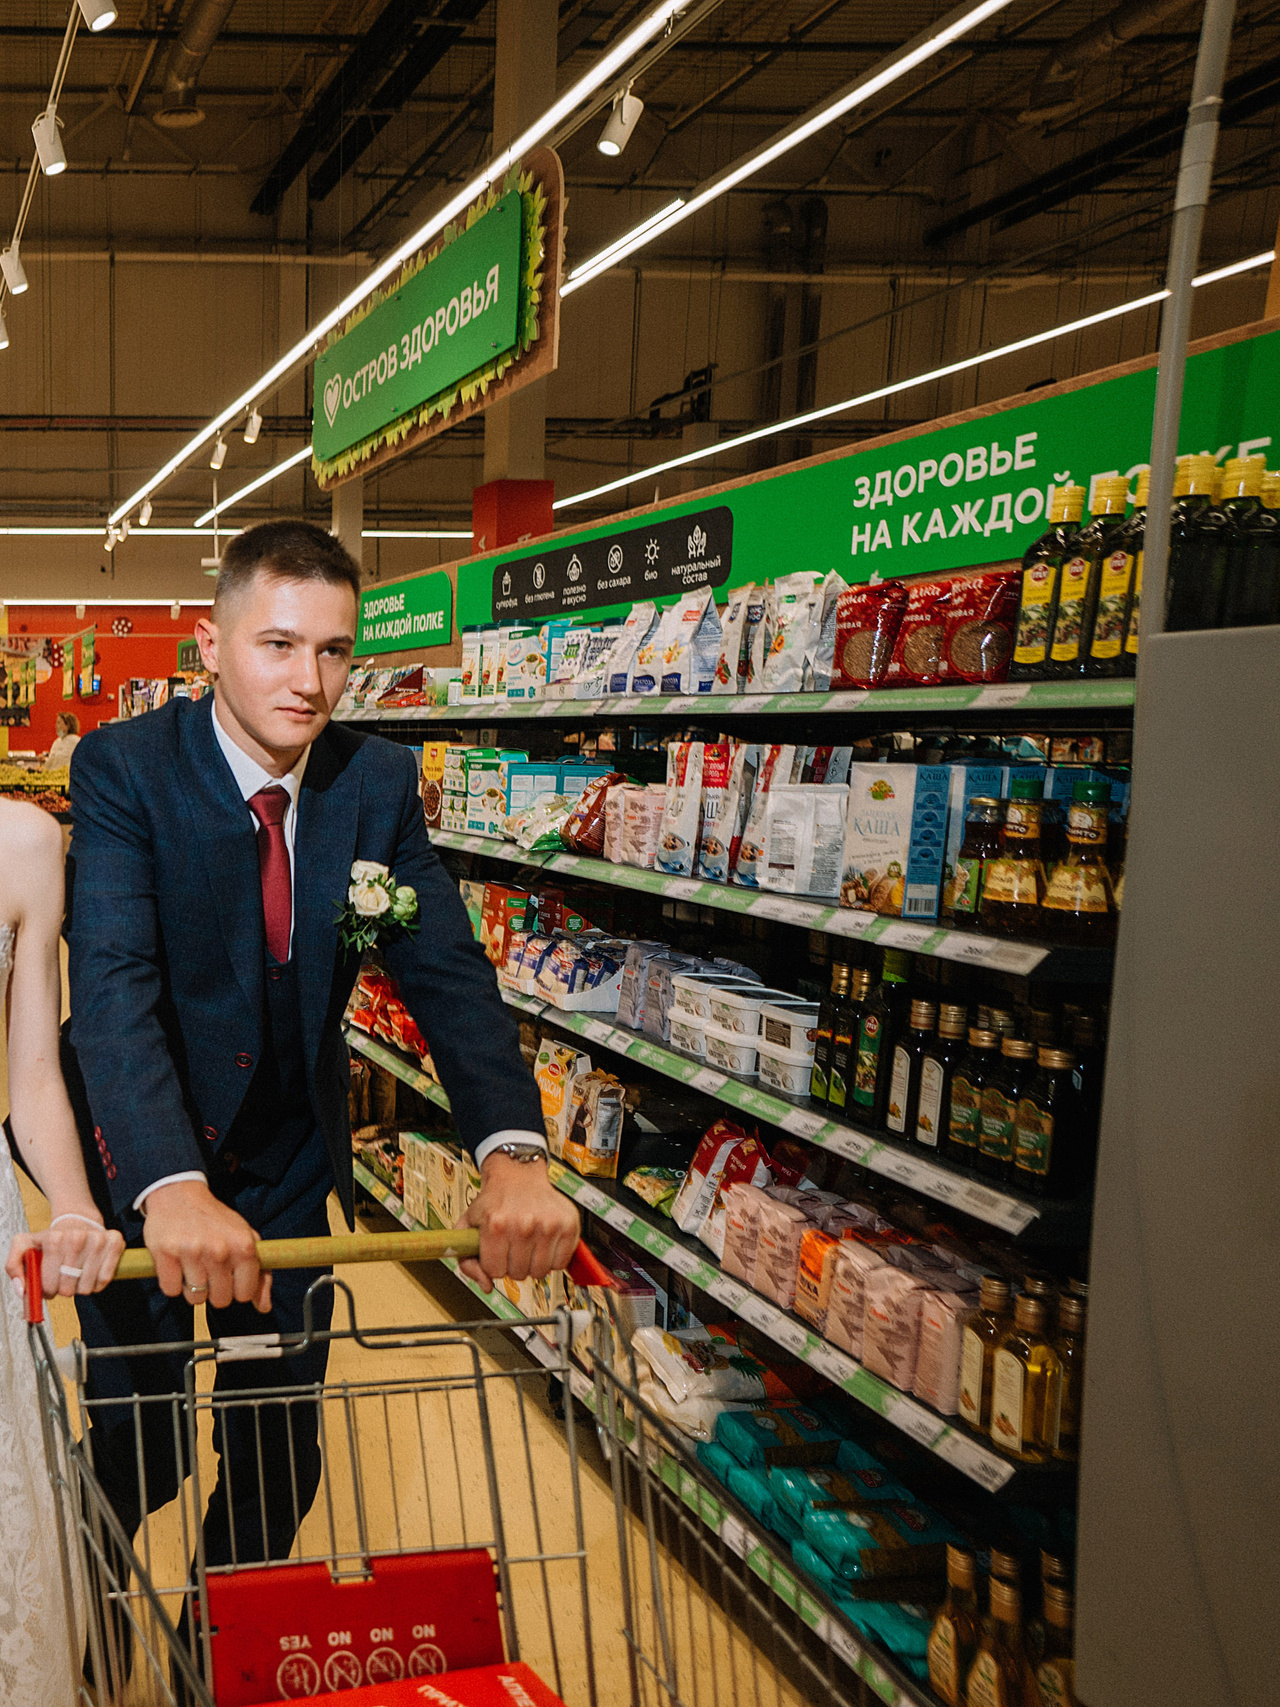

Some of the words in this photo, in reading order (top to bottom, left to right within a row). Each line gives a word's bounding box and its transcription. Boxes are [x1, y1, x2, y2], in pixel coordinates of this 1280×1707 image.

[342, 343, 398, 410] ОСТРОВ
[399, 263, 500, 371] ЗДОРОВЬЯ
[852, 431, 1039, 511] ЗДОРОВЬЕ
[850, 522, 893, 556] НА
[670, 554, 722, 577] натуральный
[597, 578, 610, 591] без
[611, 575, 632, 589] сахара
[643, 568, 659, 582] био
[681, 570, 709, 586] состав
[524, 593, 535, 604] без
[562, 584, 587, 597] полезно
[362, 592, 405, 619] ЗДОРОВЬЕ
[495, 598, 518, 611] суперфуд
[567, 593, 587, 606] вкусно
[362, 625, 373, 642] НА
[374, 616, 411, 640] КАЖДОЙ
[412, 610, 445, 632] ПОЛКЕ
[853, 817, 900, 837] КАША
[327, 1630, 352, 1647] NO
[369, 1626, 394, 1644] NO
[412, 1623, 437, 1639] NO
[279, 1633, 313, 1651] YES
